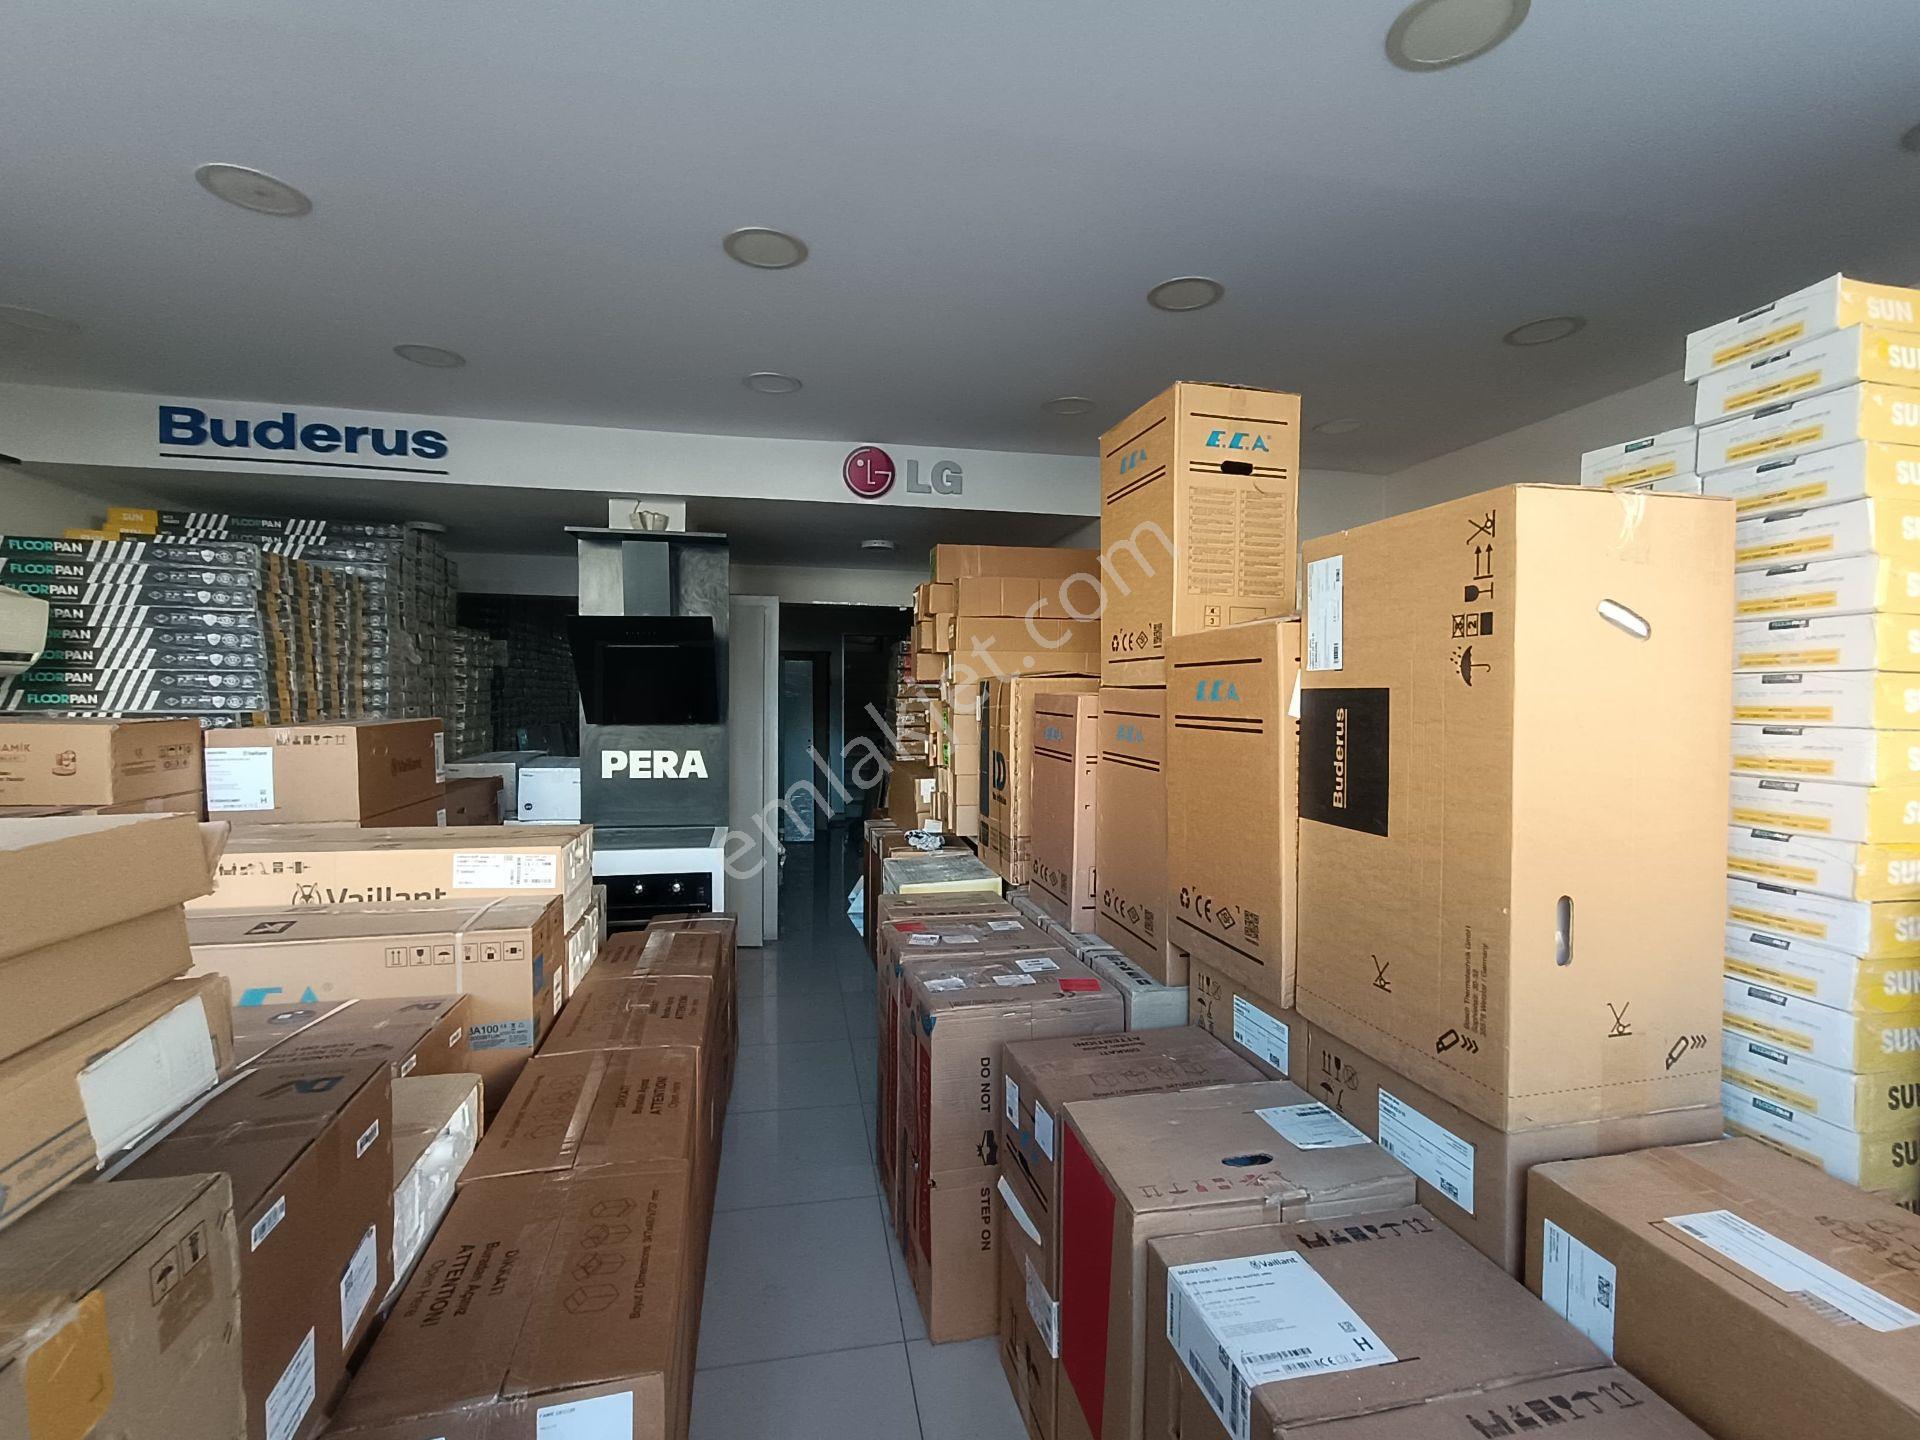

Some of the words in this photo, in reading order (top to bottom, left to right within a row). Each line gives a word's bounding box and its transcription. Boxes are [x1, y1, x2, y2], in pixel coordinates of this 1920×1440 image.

[1867, 296, 1914, 324] SUN
[1889, 344, 1920, 371] SU
[1891, 402, 1920, 427] SU
[158, 405, 449, 460] Buderus
[906, 459, 963, 495] LG
[8, 540, 83, 553] FLOORPAN
[10, 563, 84, 576] FLOORPAN
[6, 583, 79, 595] OORPAN
[22, 672, 94, 683] FLOORPAN
[27, 694, 98, 704] FLOORPAN
[0, 742, 30, 752] AMİK
[1332, 707, 1345, 808] Buderus
[601, 750, 709, 779] PERA
[981, 1057, 990, 1078] DO
[981, 1083, 990, 1113] NOT
[981, 1187, 991, 1225] STEP
[981, 1229, 991, 1251] ON
[1259, 1257, 1298, 1268] Vaillant
[420, 1245, 475, 1328] ATTENTION!
[1352, 1337, 1374, 1351] H
